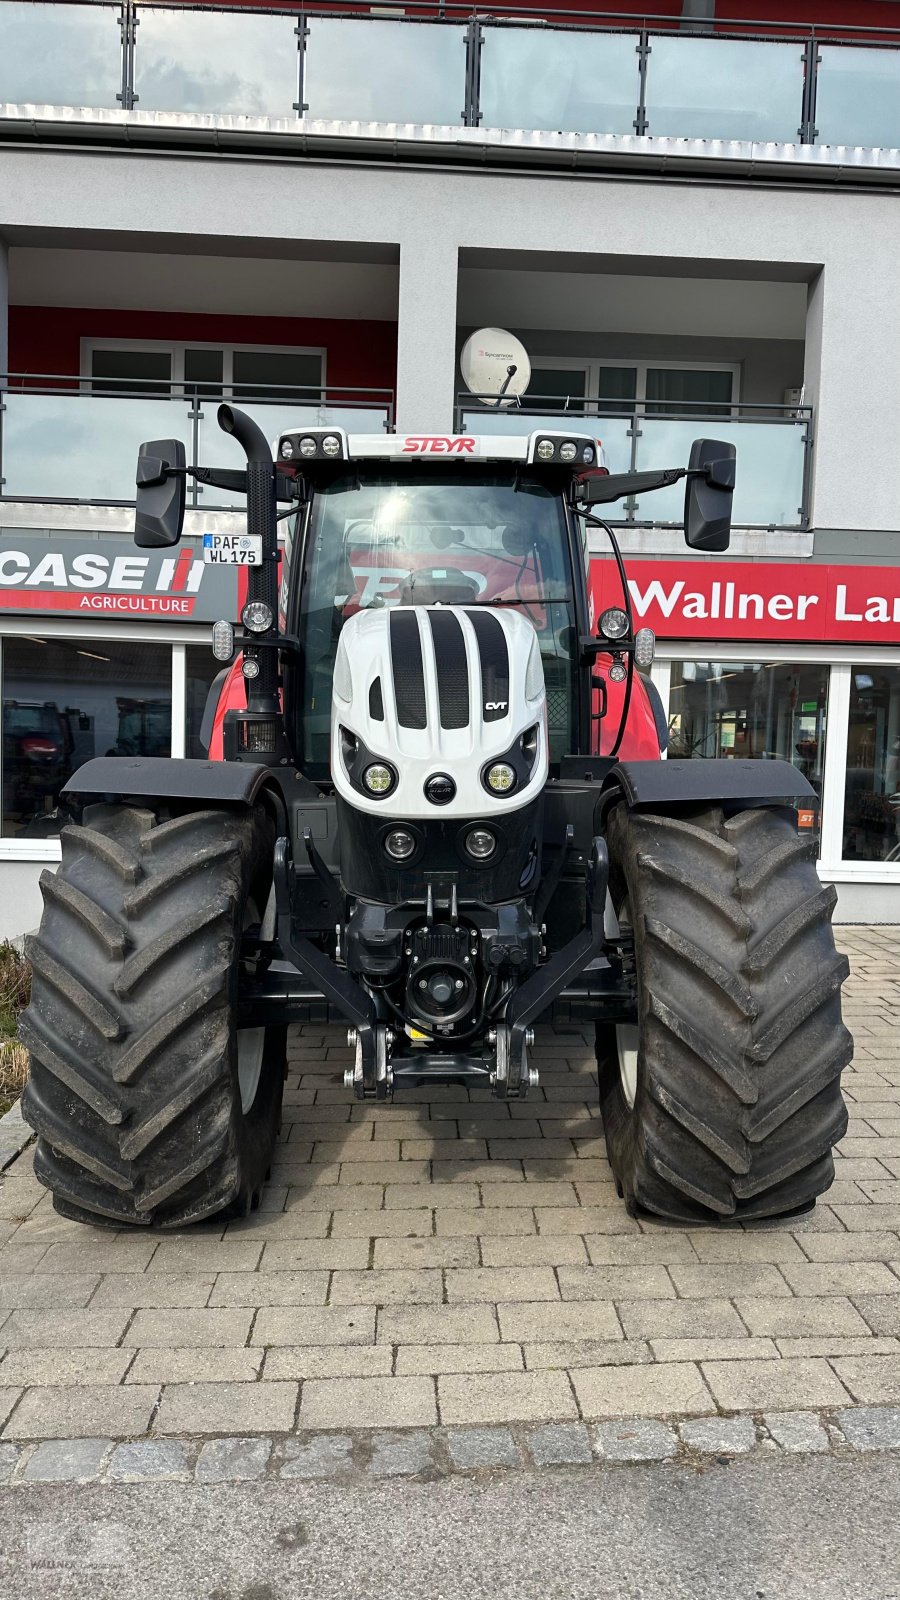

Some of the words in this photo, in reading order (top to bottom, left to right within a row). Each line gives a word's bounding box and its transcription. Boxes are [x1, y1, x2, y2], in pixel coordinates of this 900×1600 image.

[402, 437, 476, 453] STEYR
[213, 536, 240, 549] PAF
[208, 550, 227, 562] WL
[230, 550, 256, 563] 175
[0, 550, 149, 589] CASE
[80, 595, 190, 613] AGRICULTURE
[626, 579, 819, 620] Wallner
[485, 701, 508, 710] CVT
